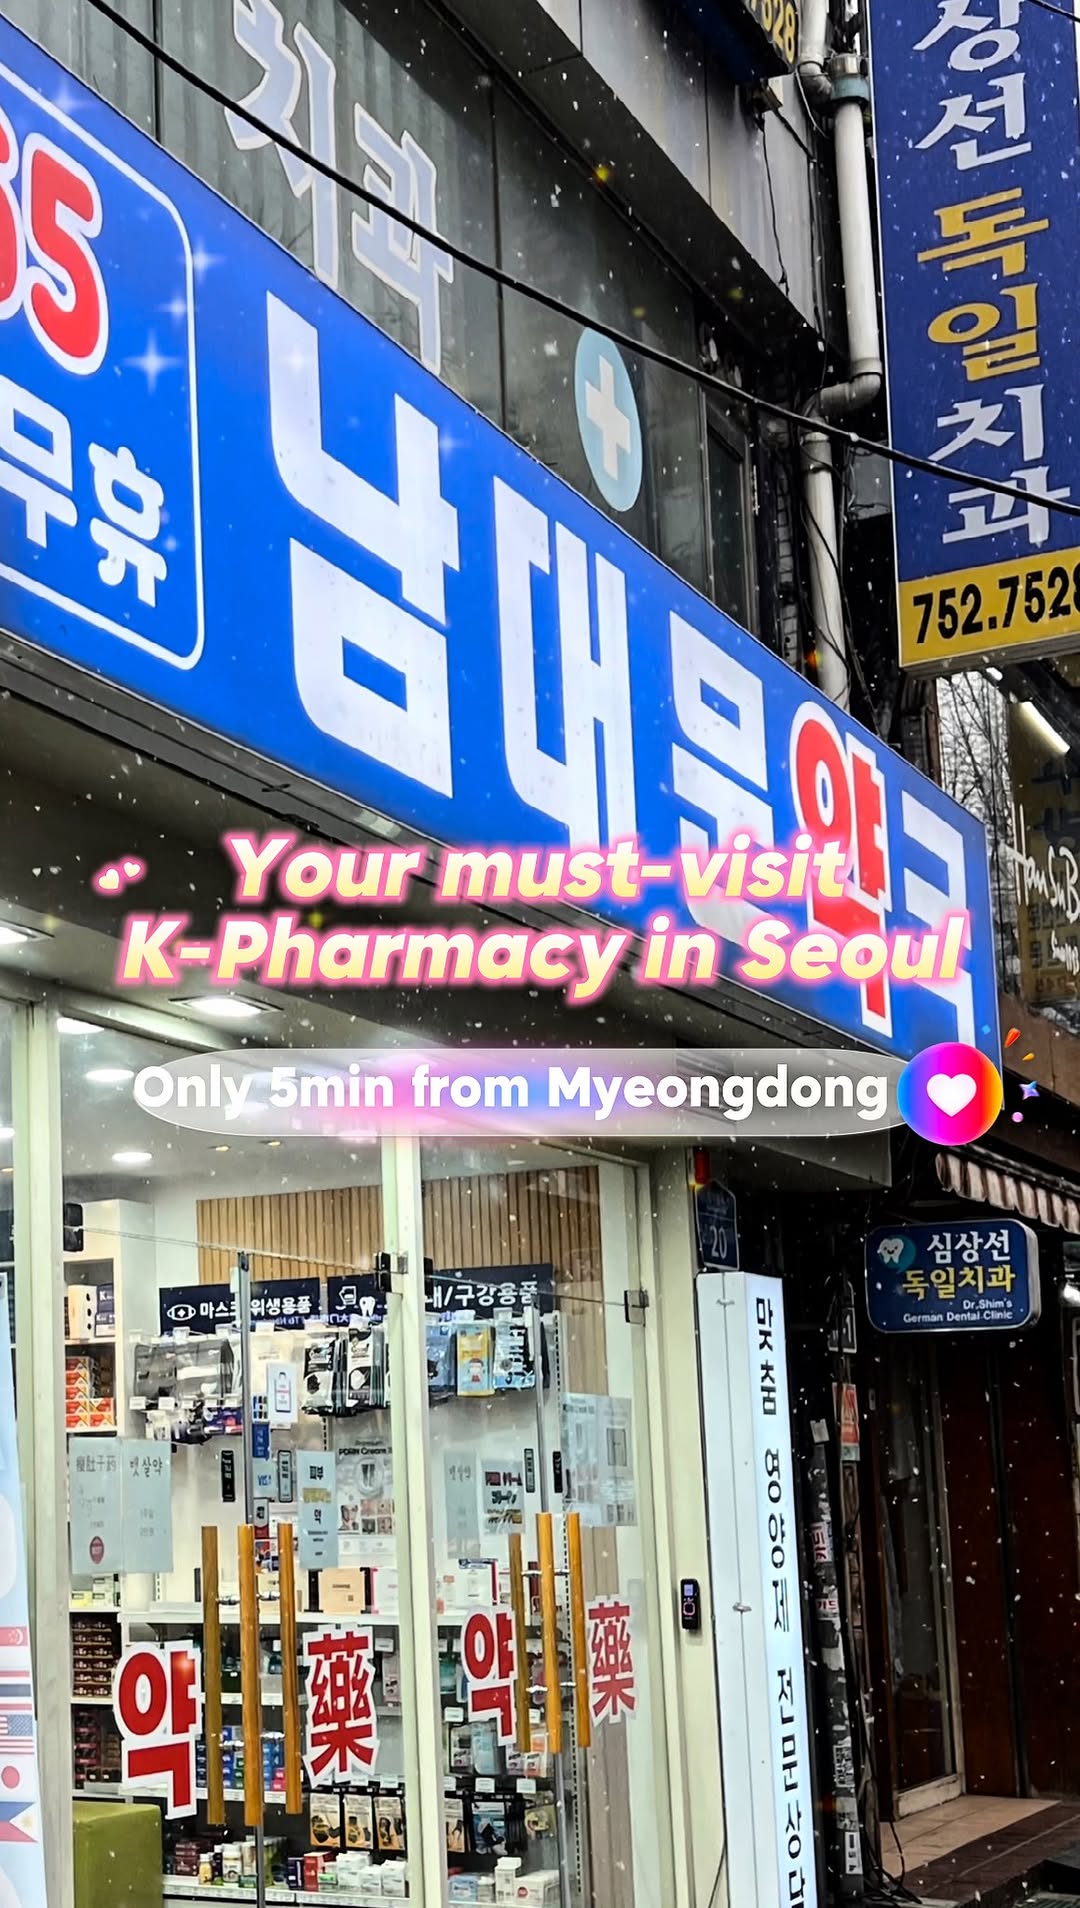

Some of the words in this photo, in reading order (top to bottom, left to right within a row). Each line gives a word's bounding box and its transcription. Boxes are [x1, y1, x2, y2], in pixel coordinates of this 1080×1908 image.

[267, 291, 977, 1047] 남대문약국
[709, 1226, 728, 1259] 20
[927, 1229, 1011, 1264] 심상선
[902, 1265, 1016, 1301] 독일치과
[903, 1314, 943, 1324] German
[946, 1311, 980, 1322] Dental
[983, 1310, 1013, 1320] Clinic
[963, 1299, 1013, 1311] Dr.Shim's
[756, 1297, 777, 1416] 맞춤
[765, 1449, 790, 1632] 영양제
[463, 1611, 515, 1739] 약
[588, 1602, 636, 1717] 藥
[118, 1650, 197, 1809] 약
[307, 1631, 374, 1777] 藥
